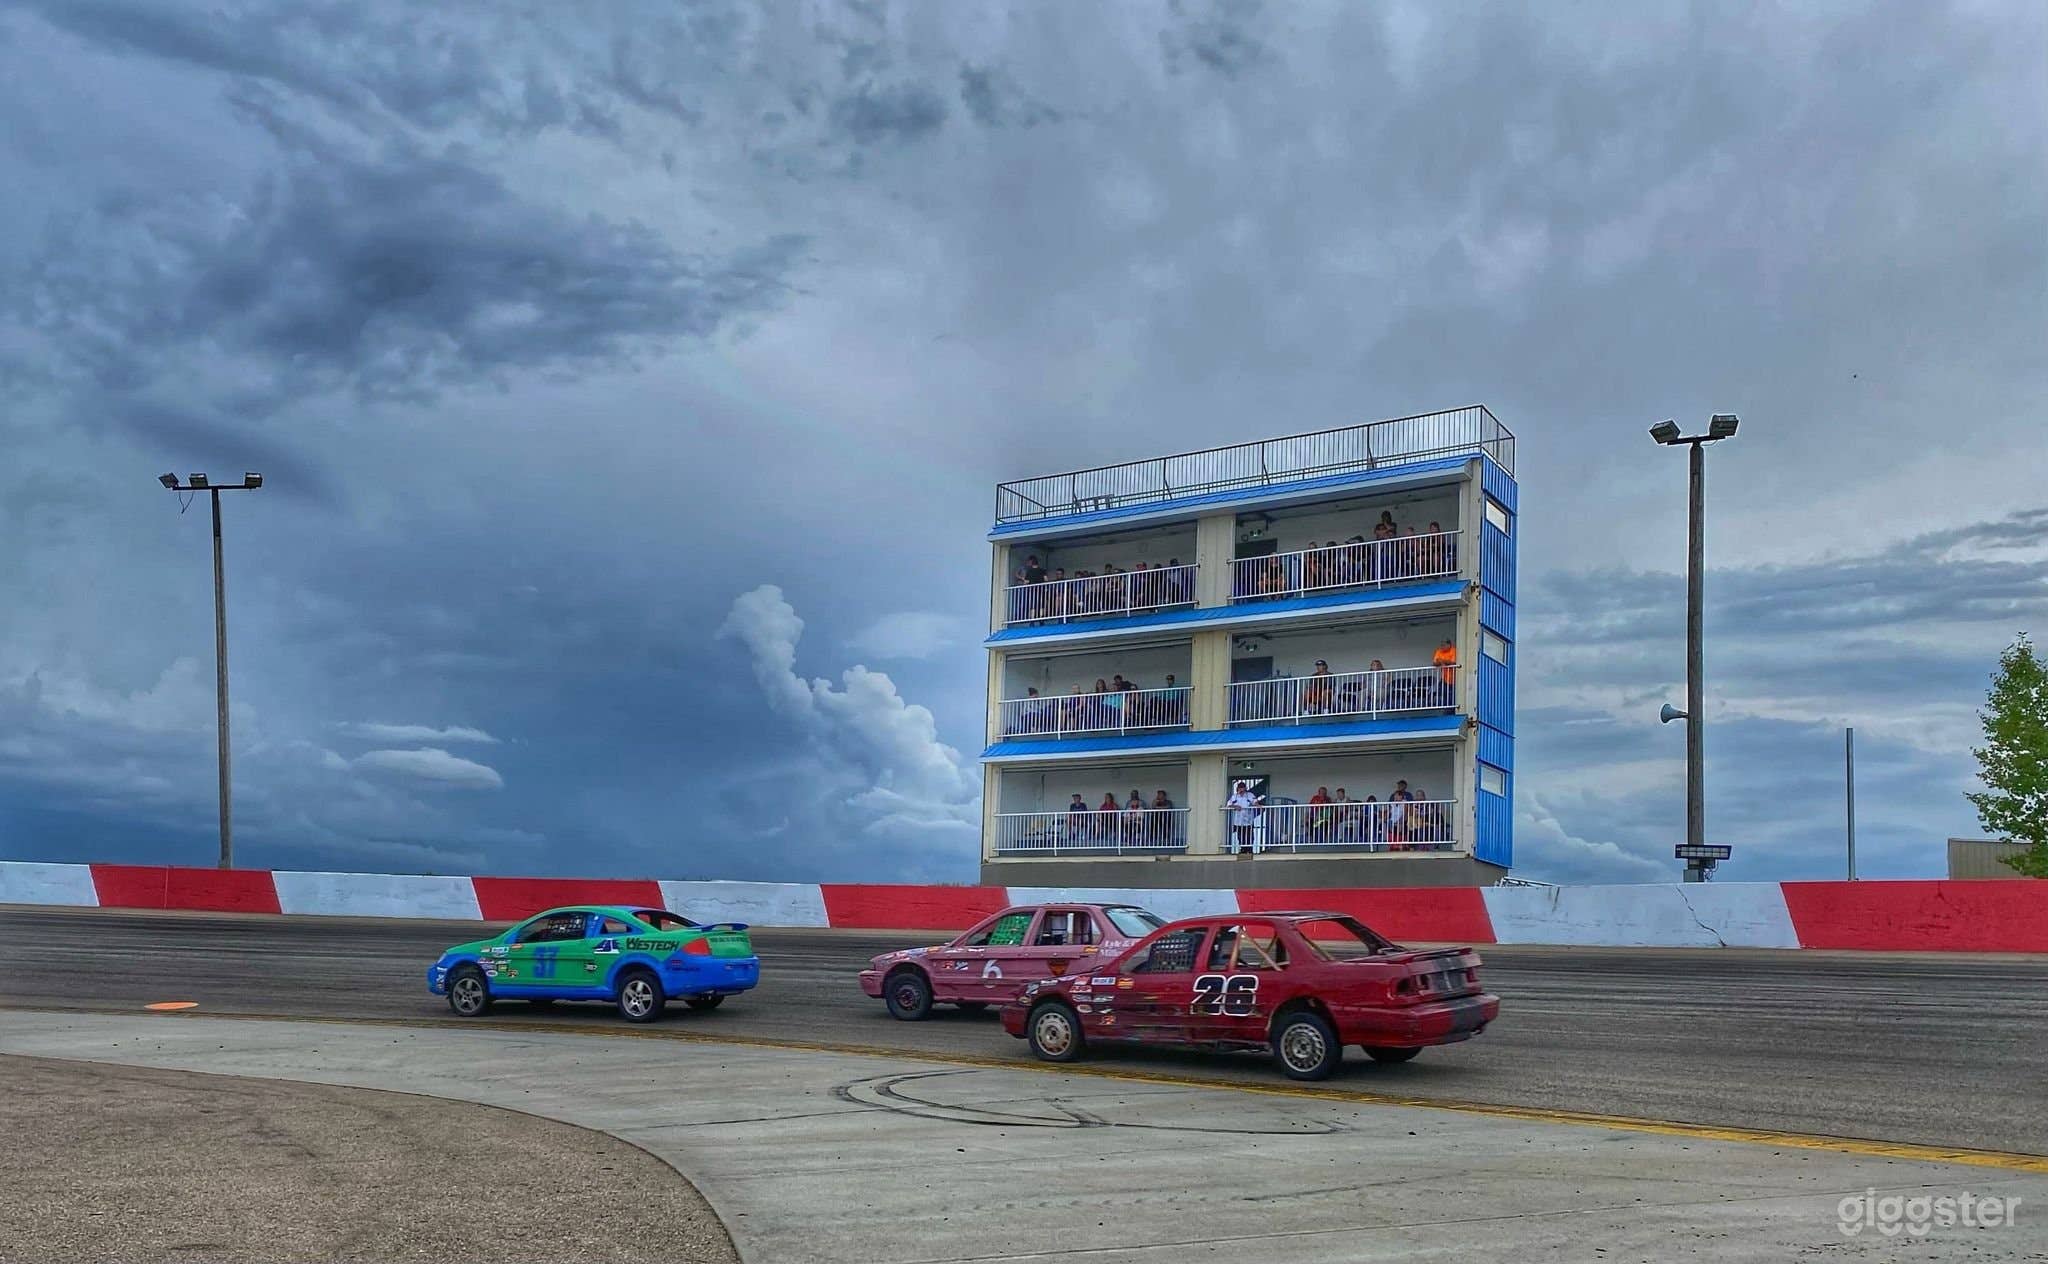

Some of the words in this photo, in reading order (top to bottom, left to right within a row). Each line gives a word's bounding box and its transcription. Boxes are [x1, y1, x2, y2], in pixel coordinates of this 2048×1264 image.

[626, 937, 680, 951] WESTECH
[981, 959, 1003, 988] 6
[1190, 974, 1259, 1017] 26
